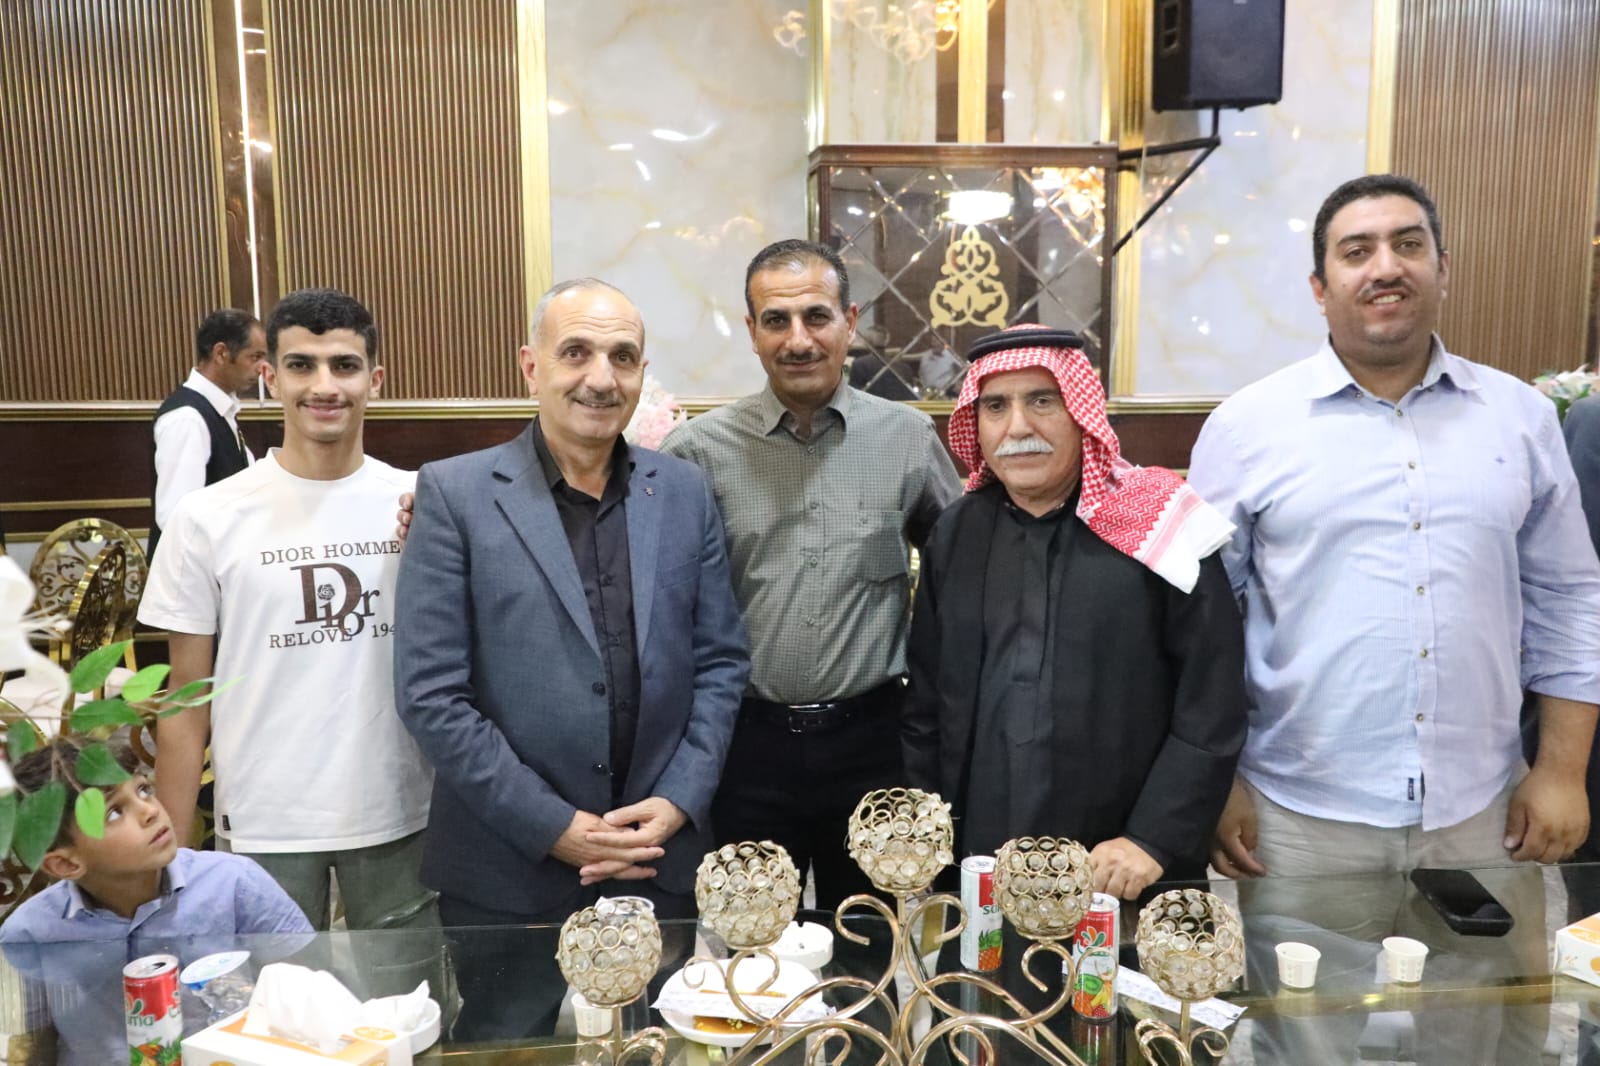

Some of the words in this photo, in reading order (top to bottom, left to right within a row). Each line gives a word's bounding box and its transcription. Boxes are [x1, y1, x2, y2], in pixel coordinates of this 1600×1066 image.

[260, 546, 315, 565] DIOR
[323, 540, 400, 558] HOMME
[269, 628, 352, 648] RELOVE
